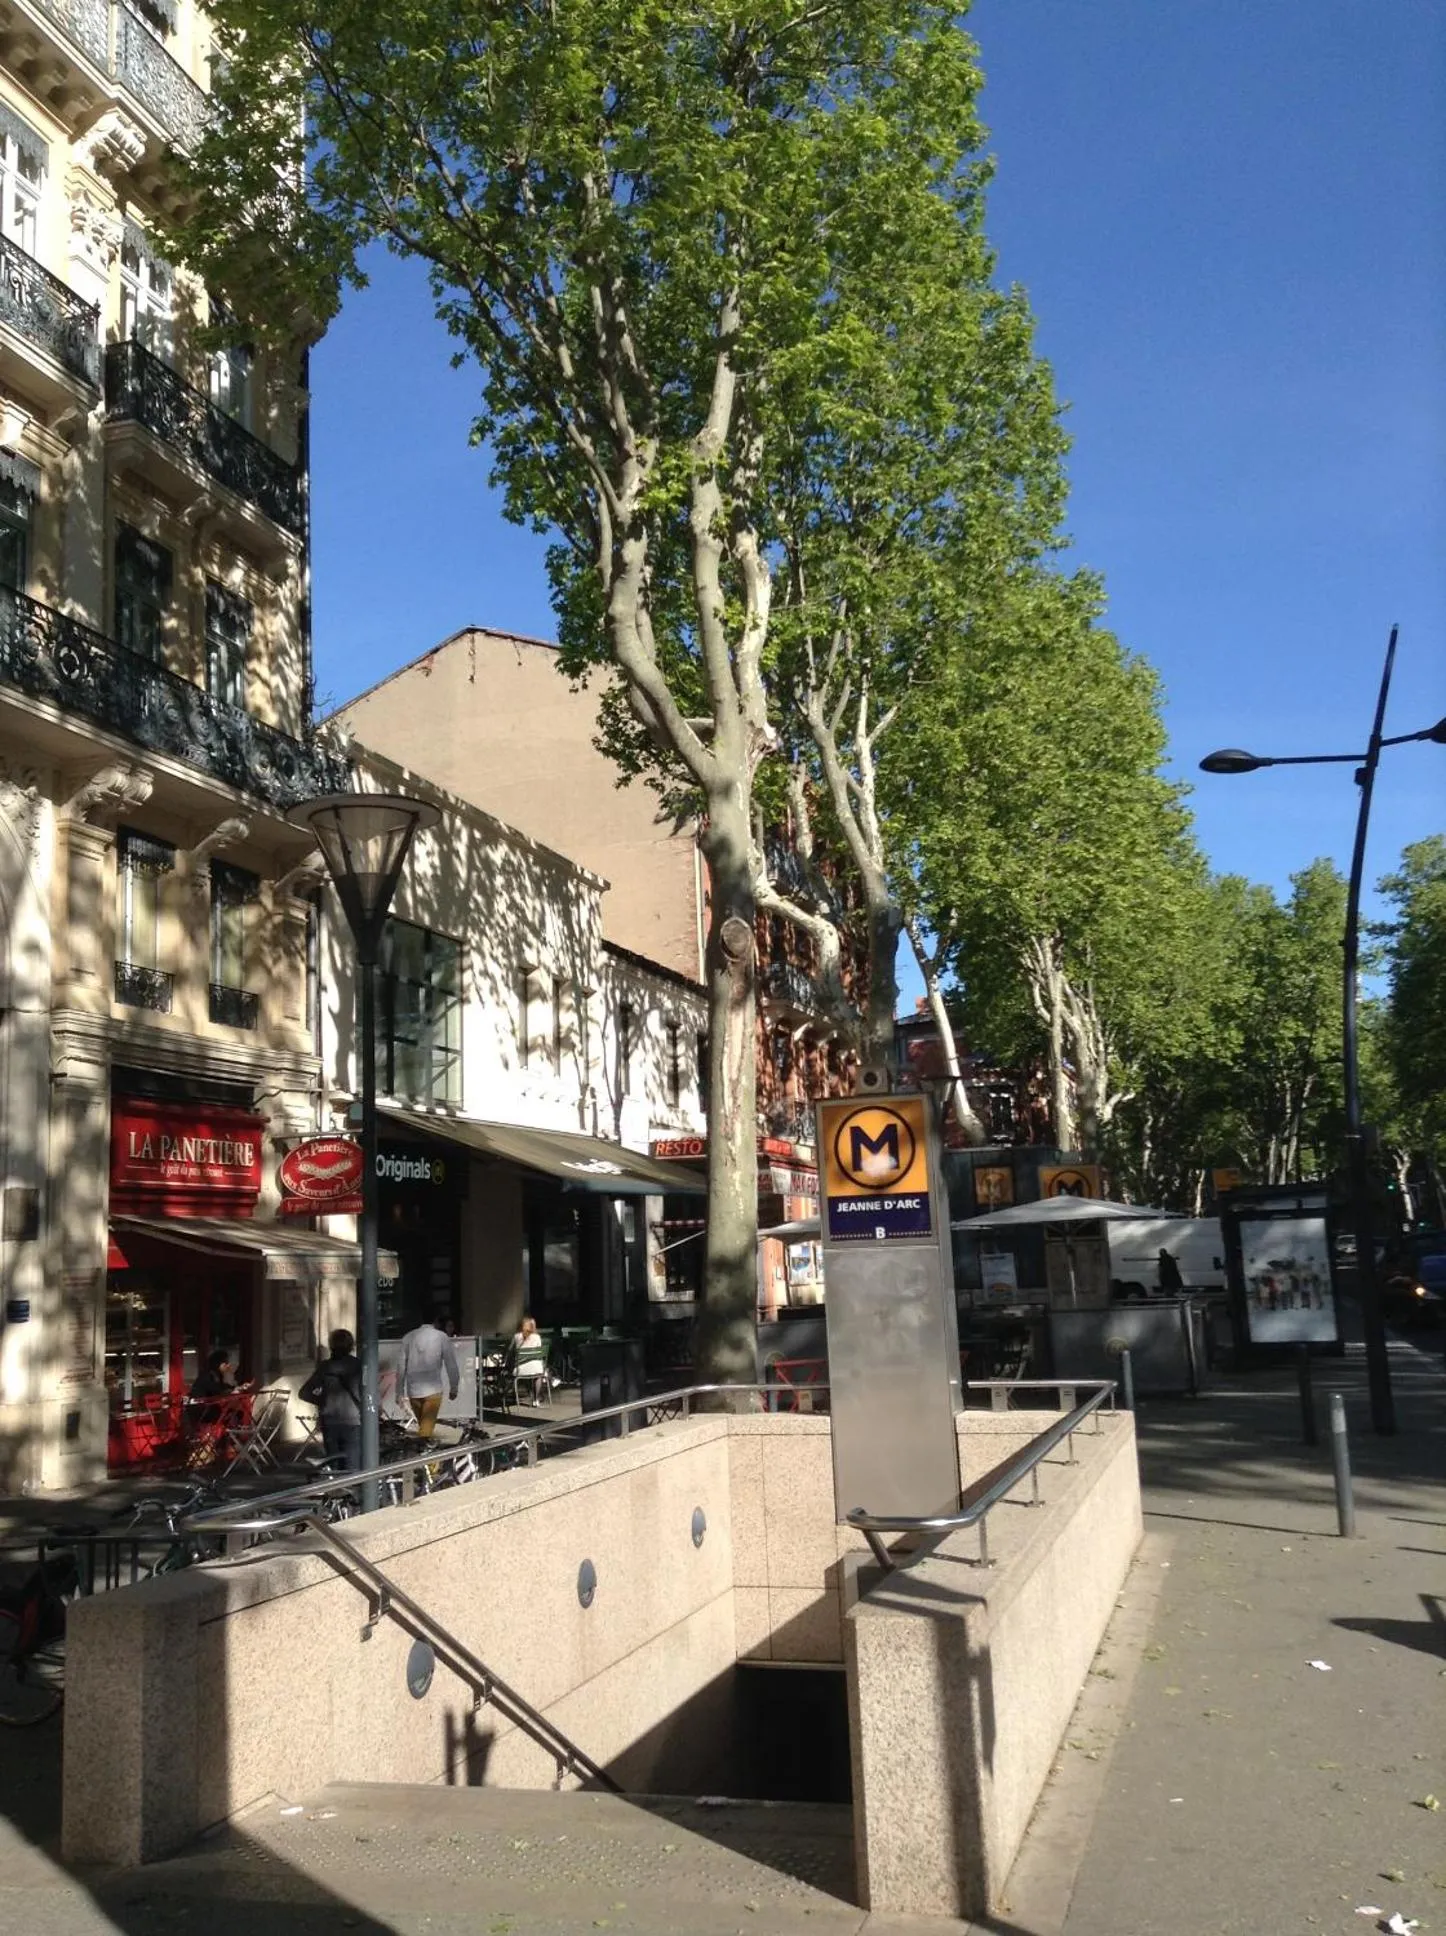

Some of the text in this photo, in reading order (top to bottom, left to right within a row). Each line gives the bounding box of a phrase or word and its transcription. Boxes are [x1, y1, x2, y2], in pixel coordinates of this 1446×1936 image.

[128, 1131, 255, 1167] LA PANETIÈRE
[655, 1140, 703, 1156] RESTO
[850, 1124, 900, 1172] M
[376, 1154, 431, 1182] Originals
[837, 1199, 921, 1213] JEANNE D'ARC
[875, 1226, 886, 1239] B
